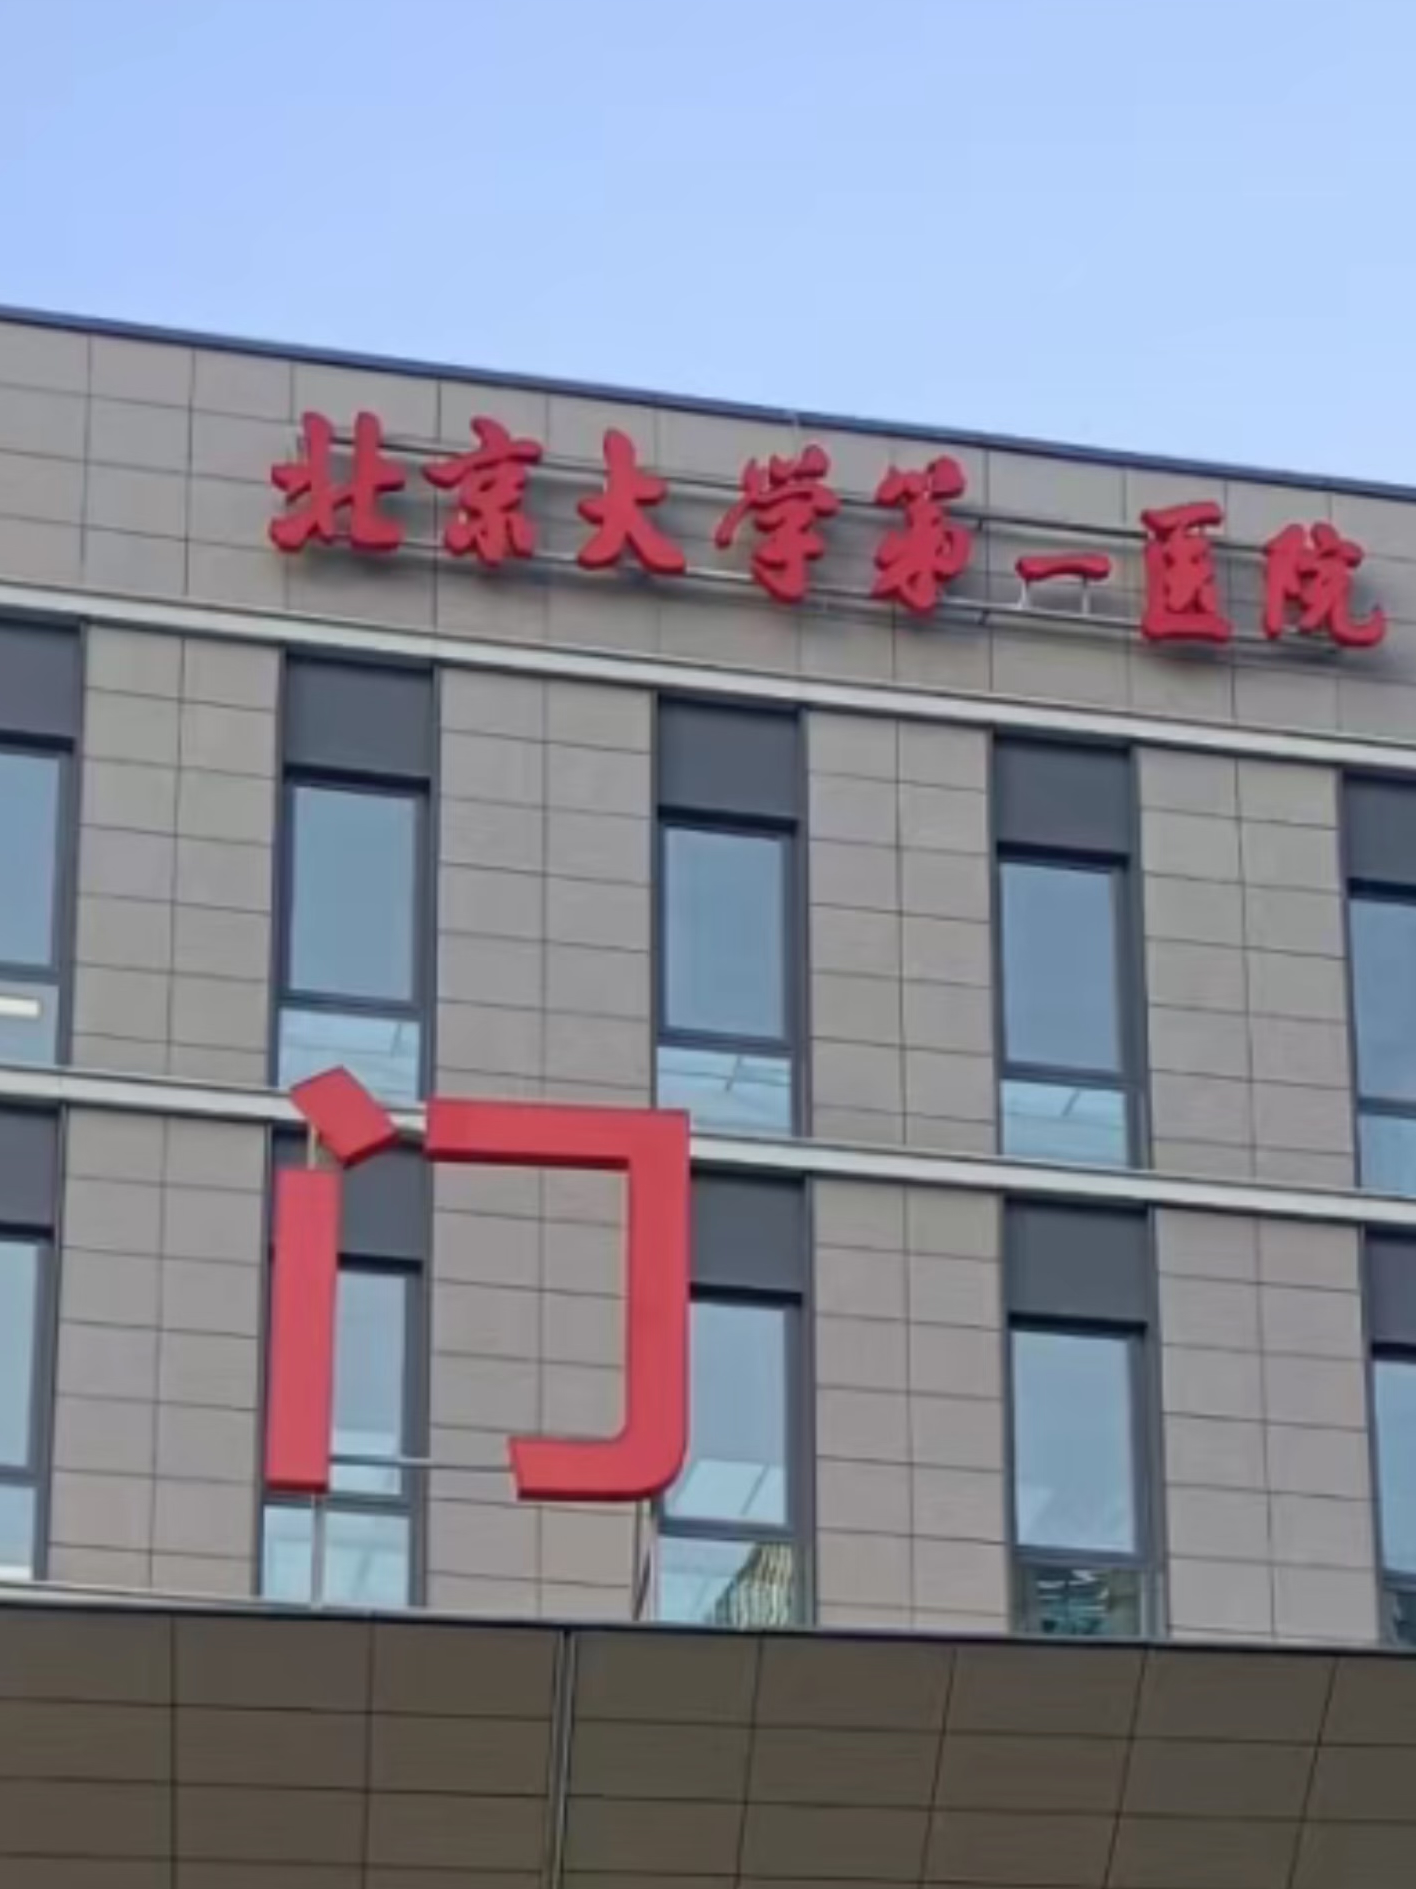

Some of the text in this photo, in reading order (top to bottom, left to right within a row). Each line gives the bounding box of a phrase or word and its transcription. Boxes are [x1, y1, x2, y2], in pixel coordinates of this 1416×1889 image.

[270, 412, 1384, 648] 北京大学第一医院
